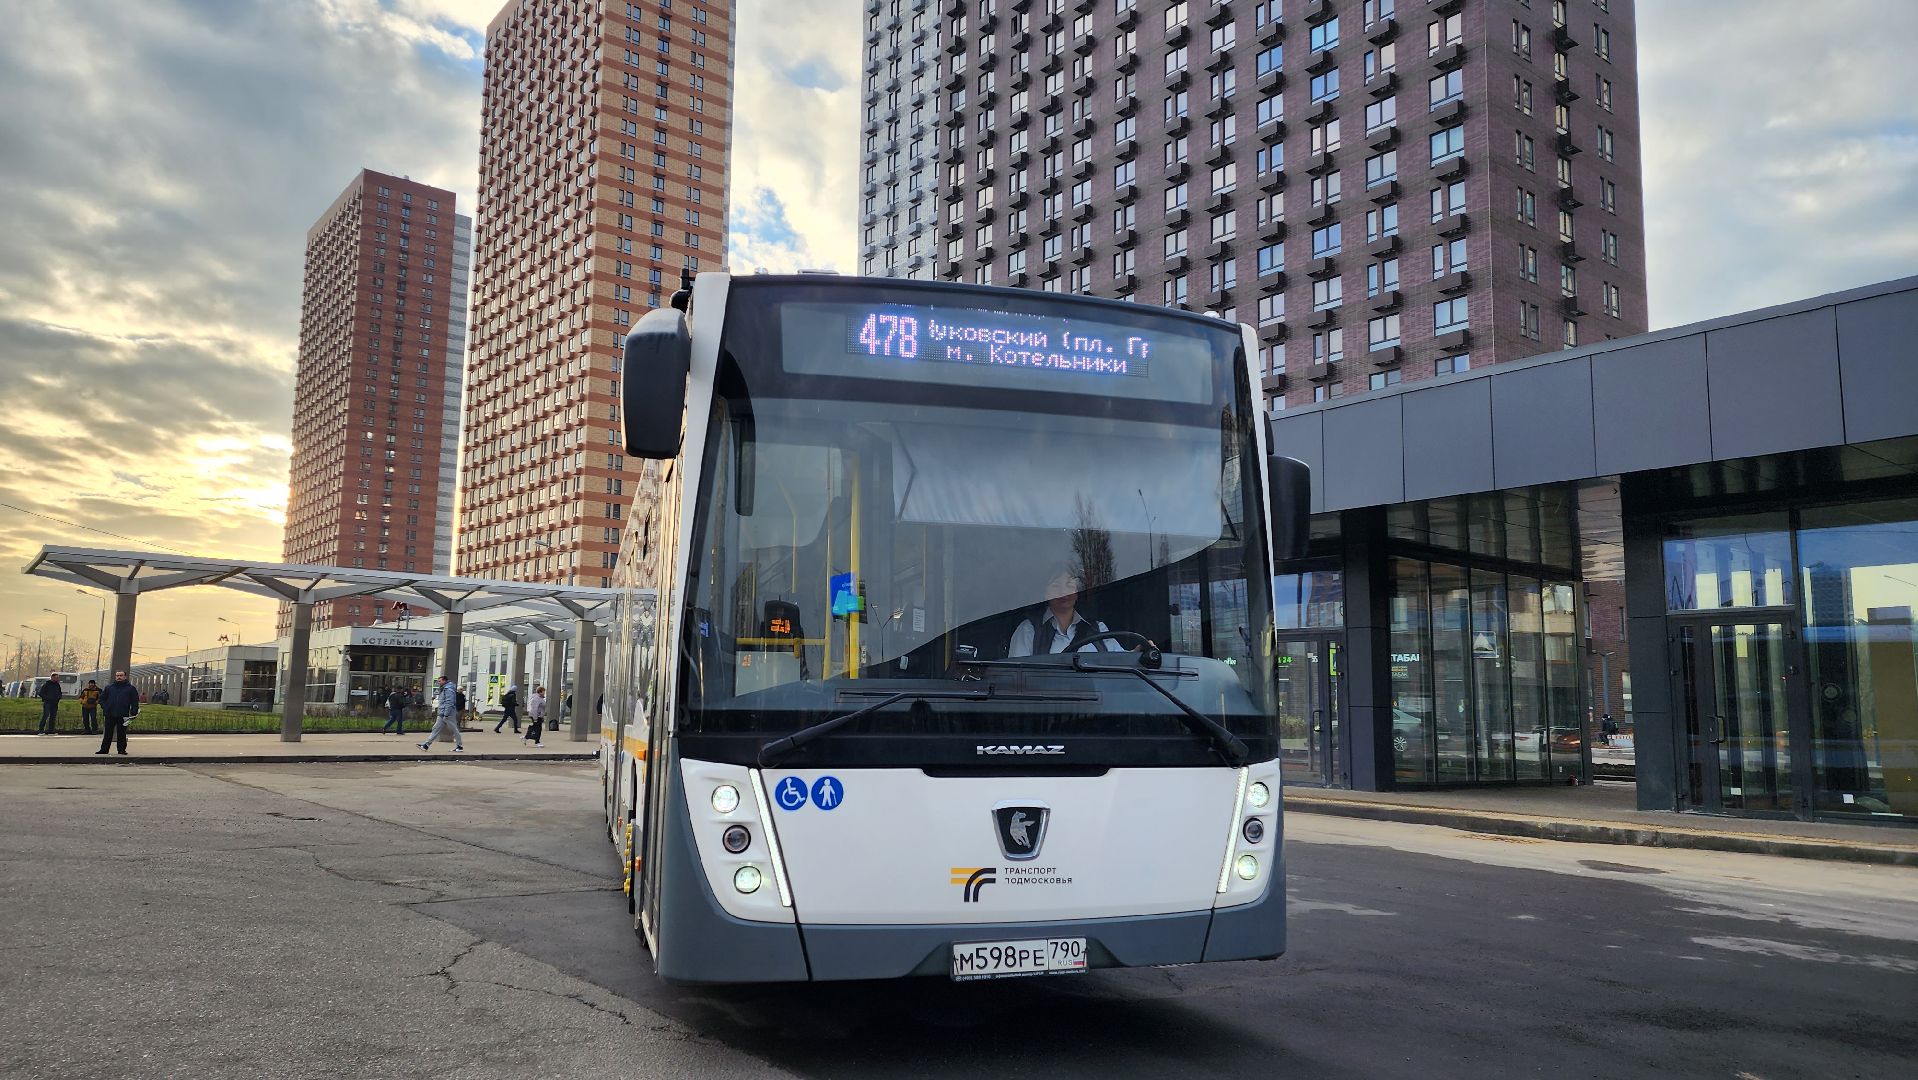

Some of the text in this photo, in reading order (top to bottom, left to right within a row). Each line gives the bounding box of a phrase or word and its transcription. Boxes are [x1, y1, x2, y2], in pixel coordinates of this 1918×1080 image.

[859, 313, 917, 358] 478
[1063, 331, 1114, 353] (пл.
[947, 344, 1128, 374] м. Котельники
[361, 637, 433, 647] КОТЕЛЬНИКИ
[976, 745, 1066, 755] KAMAZ
[1004, 867, 1057, 875] ТРАНСПОРТ
[959, 940, 1081, 971] М598РЕ 790
